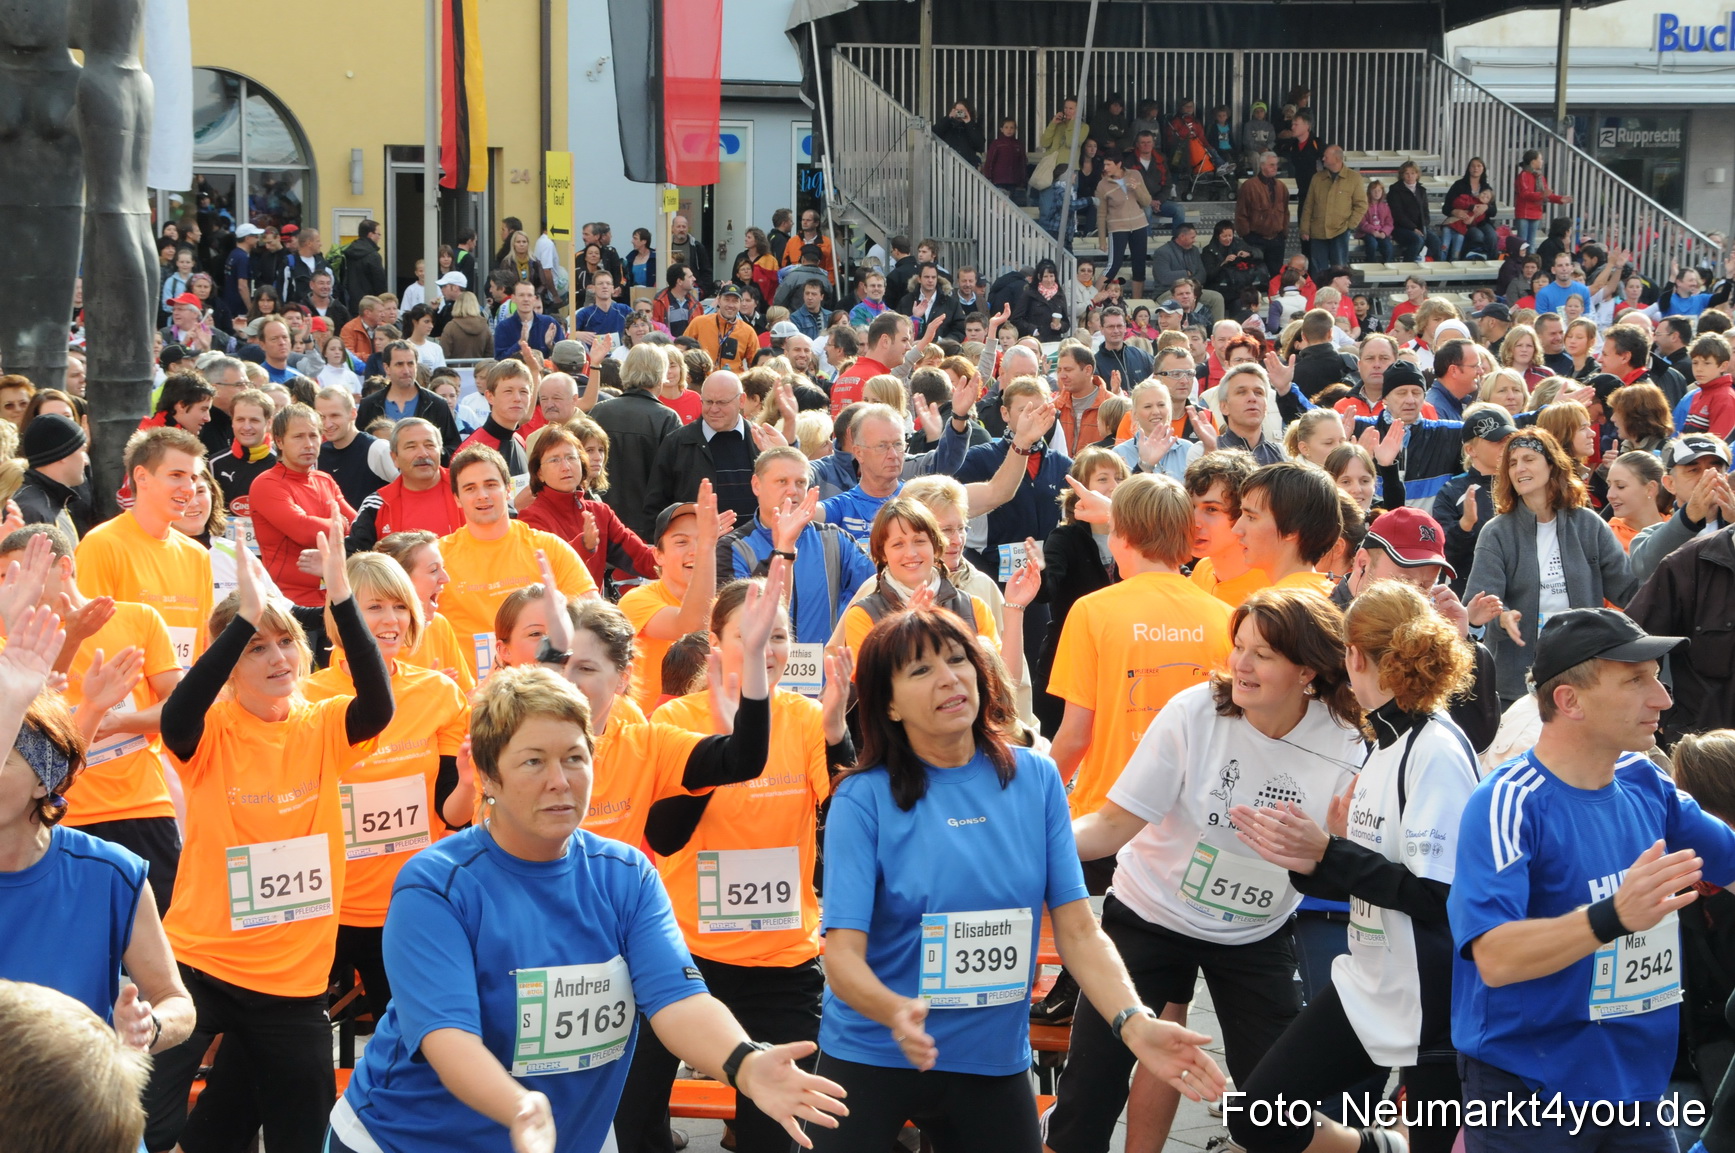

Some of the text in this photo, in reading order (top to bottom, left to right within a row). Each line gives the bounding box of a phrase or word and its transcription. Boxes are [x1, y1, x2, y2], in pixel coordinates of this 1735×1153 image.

[1617, 127, 1681, 148] Rupprecht
[510, 169, 530, 185] 24
[548, 175, 571, 192] Jugend-
[554, 192, 565, 206] lauf
[1133, 623, 1204, 642] Roland
[173, 643, 189, 657] 15
[783, 663, 817, 676] 2039
[362, 804, 419, 833] 5217
[395, 836, 429, 848] PFLEIDERER
[260, 868, 323, 899] 5215
[727, 880, 791, 906] 5219
[1211, 877, 1274, 908] 5158
[295, 903, 331, 916] PFLEIDERER
[762, 917, 800, 926] PFLEIDERER
[954, 919, 1012, 939] Elisabeth
[1625, 933, 1646, 950] Max
[928, 950, 935, 962] D
[955, 946, 1018, 974] 3399
[1602, 963, 1609, 975] B
[1625, 949, 1673, 983] 2542
[554, 976, 611, 998] Andrea
[988, 988, 1025, 1000] PFLEIDERER
[523, 1013, 531, 1028] S
[554, 1000, 626, 1040] 5163
[591, 1043, 624, 1062] PFLEIDERE
